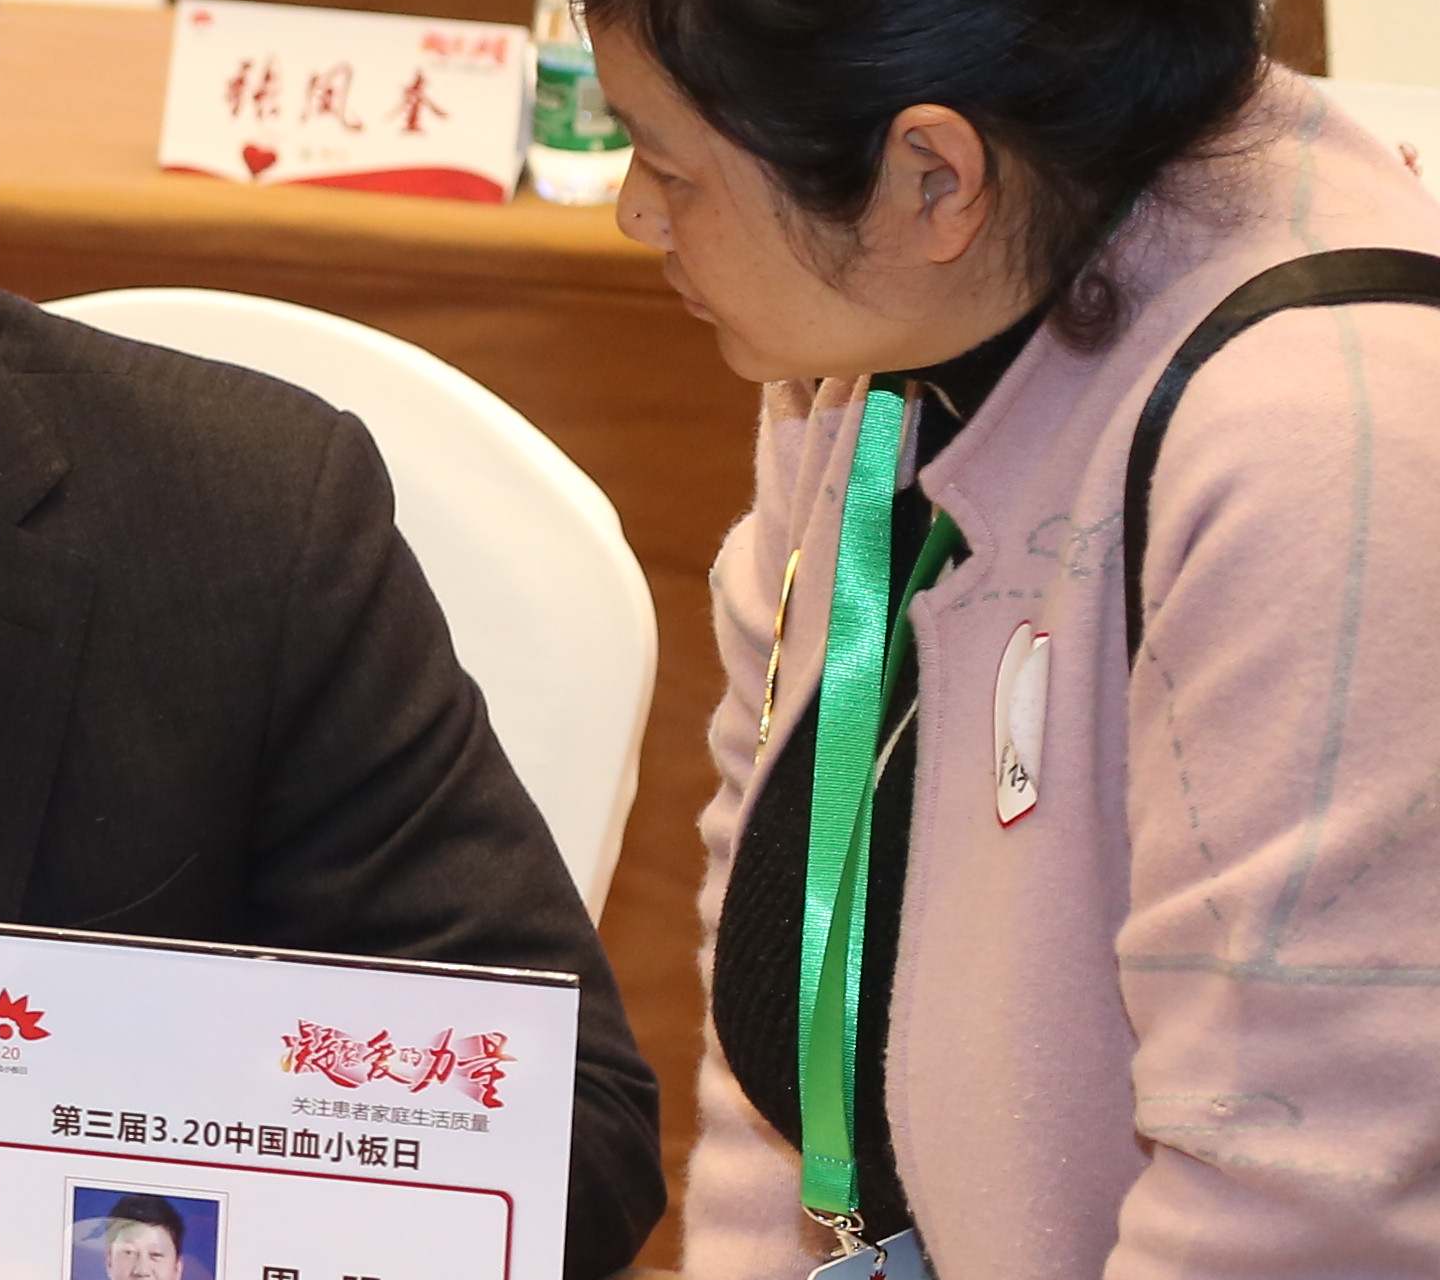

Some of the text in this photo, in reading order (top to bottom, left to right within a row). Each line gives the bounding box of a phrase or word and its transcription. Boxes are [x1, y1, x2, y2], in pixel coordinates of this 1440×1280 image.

[278, 1018, 518, 1109] 凝聚爱的力量
[50, 1104, 421, 1170] 第三届3.20中国血小板日
[290, 1096, 491, 1133] 关注患者家庭生活质量
